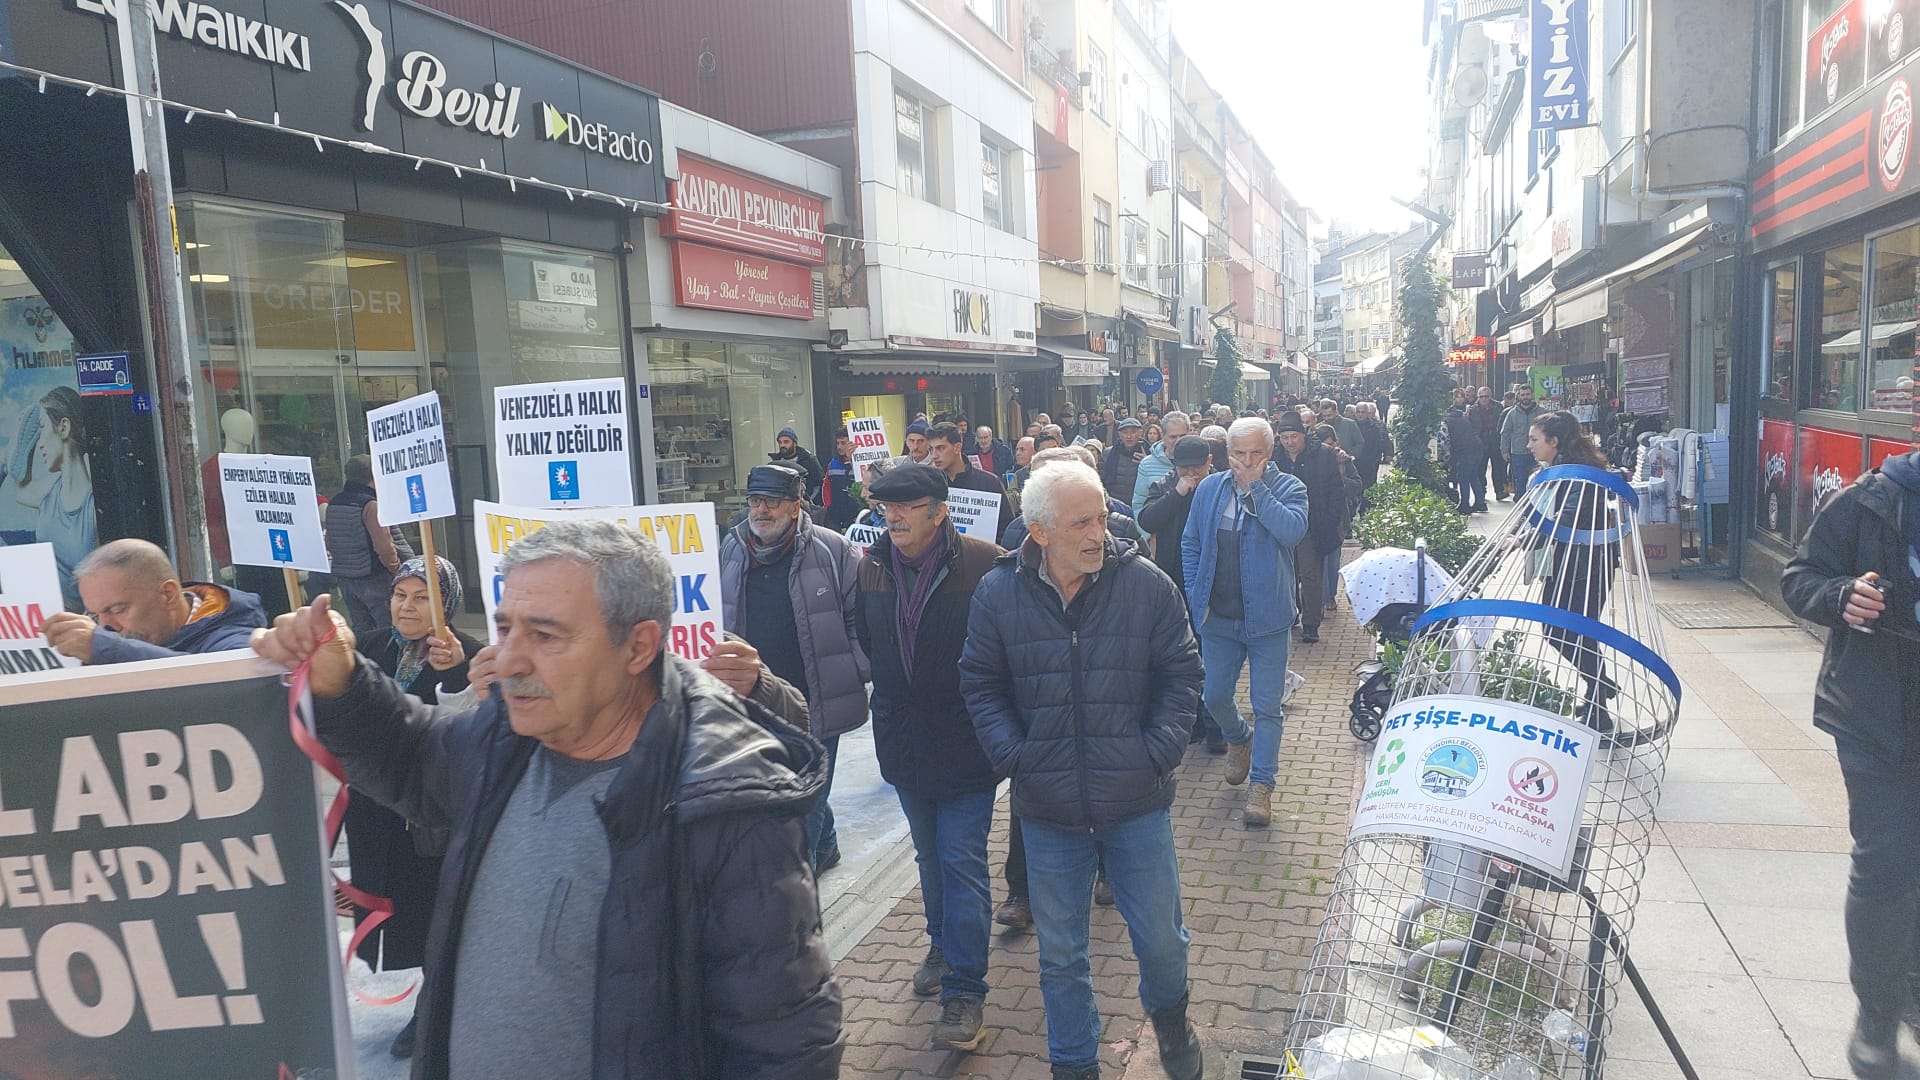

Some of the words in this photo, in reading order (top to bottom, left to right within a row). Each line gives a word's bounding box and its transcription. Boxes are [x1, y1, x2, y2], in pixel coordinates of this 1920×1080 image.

[396, 50, 522, 139] Beril
[566, 112, 653, 165] DeFacto
[734, 259, 769, 281] Yöresel
[1455, 267, 1484, 278] LAFF
[686, 276, 711, 301] Yağ
[719, 281, 741, 299] Bal
[748, 287, 777, 307] Peynir
[778, 291, 810, 310] Çeşitleri
[79, 361, 90, 373] 14.
[90, 359, 115, 372] CADDE
[500, 393, 574, 421] VENEZUELA
[578, 389, 622, 416] HALKI
[371, 410, 416, 443] VENEZUELA
[416, 402, 441, 428] HALKI
[851, 417, 880, 432] KATİL
[506, 431, 552, 457] YALNIZ
[557, 423, 623, 454] DEĞİLDİR
[853, 432, 885, 448] ABD
[379, 449, 407, 476] YALNIZ
[407, 435, 445, 469] DEĞİLDİR
[223, 467, 278, 483] EMPERYALİSTLER
[278, 468, 312, 487] YENİLECEK
[245, 486, 268, 504] EZİLEN
[268, 489, 297, 505] HALKLAR
[255, 509, 295, 526] KAZANACAK
[1384, 712, 1412, 733] PET
[1413, 705, 1581, 758] ŞİŞE-PLASTİK
[52, 723, 264, 832] ABD
[1376, 777, 1391, 788] GERİ
[1365, 788, 1399, 800] DÖNÜŞÜM
[1504, 795, 1549, 816] ATEŞLE
[1375, 811, 1410, 820] HAVASINI
[1413, 814, 1450, 826] ALARAK
[1407, 802, 1424, 811] PET
[1425, 803, 1467, 818] ŞİŞELERİ
[1469, 812, 1537, 840] BOŞALTARAK
[1539, 835, 1552, 847] VE
[1490, 801, 1555, 832] YAKLAŞMA
[0, 833, 286, 909] ELA'DAN
